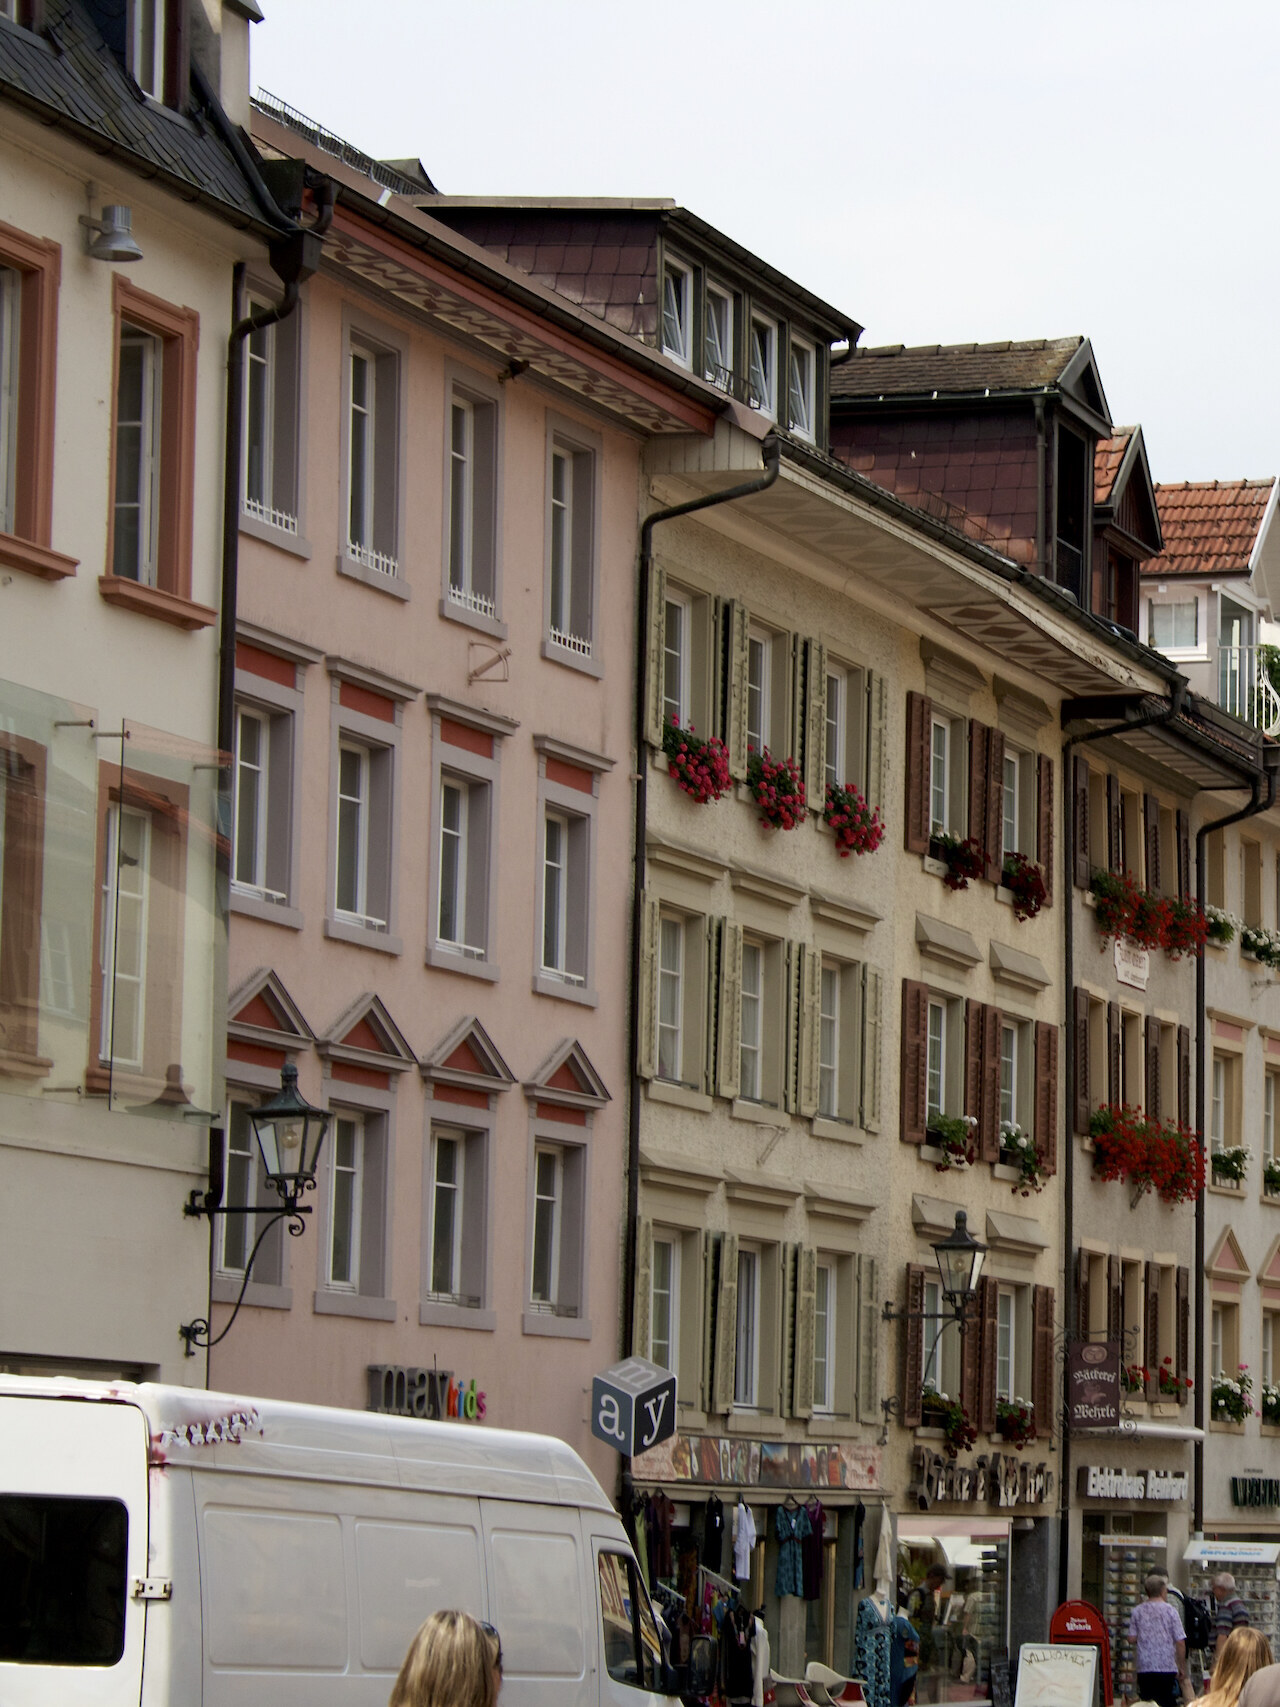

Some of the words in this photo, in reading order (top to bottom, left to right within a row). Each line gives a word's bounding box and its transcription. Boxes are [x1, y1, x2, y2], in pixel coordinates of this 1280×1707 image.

[1073, 1369, 1117, 1385] Bäckerei
[1073, 1403, 1117, 1420] Wehrle
[1086, 1465, 1145, 1499] Elektrohaus
[1146, 1469, 1189, 1500] Reinhard
